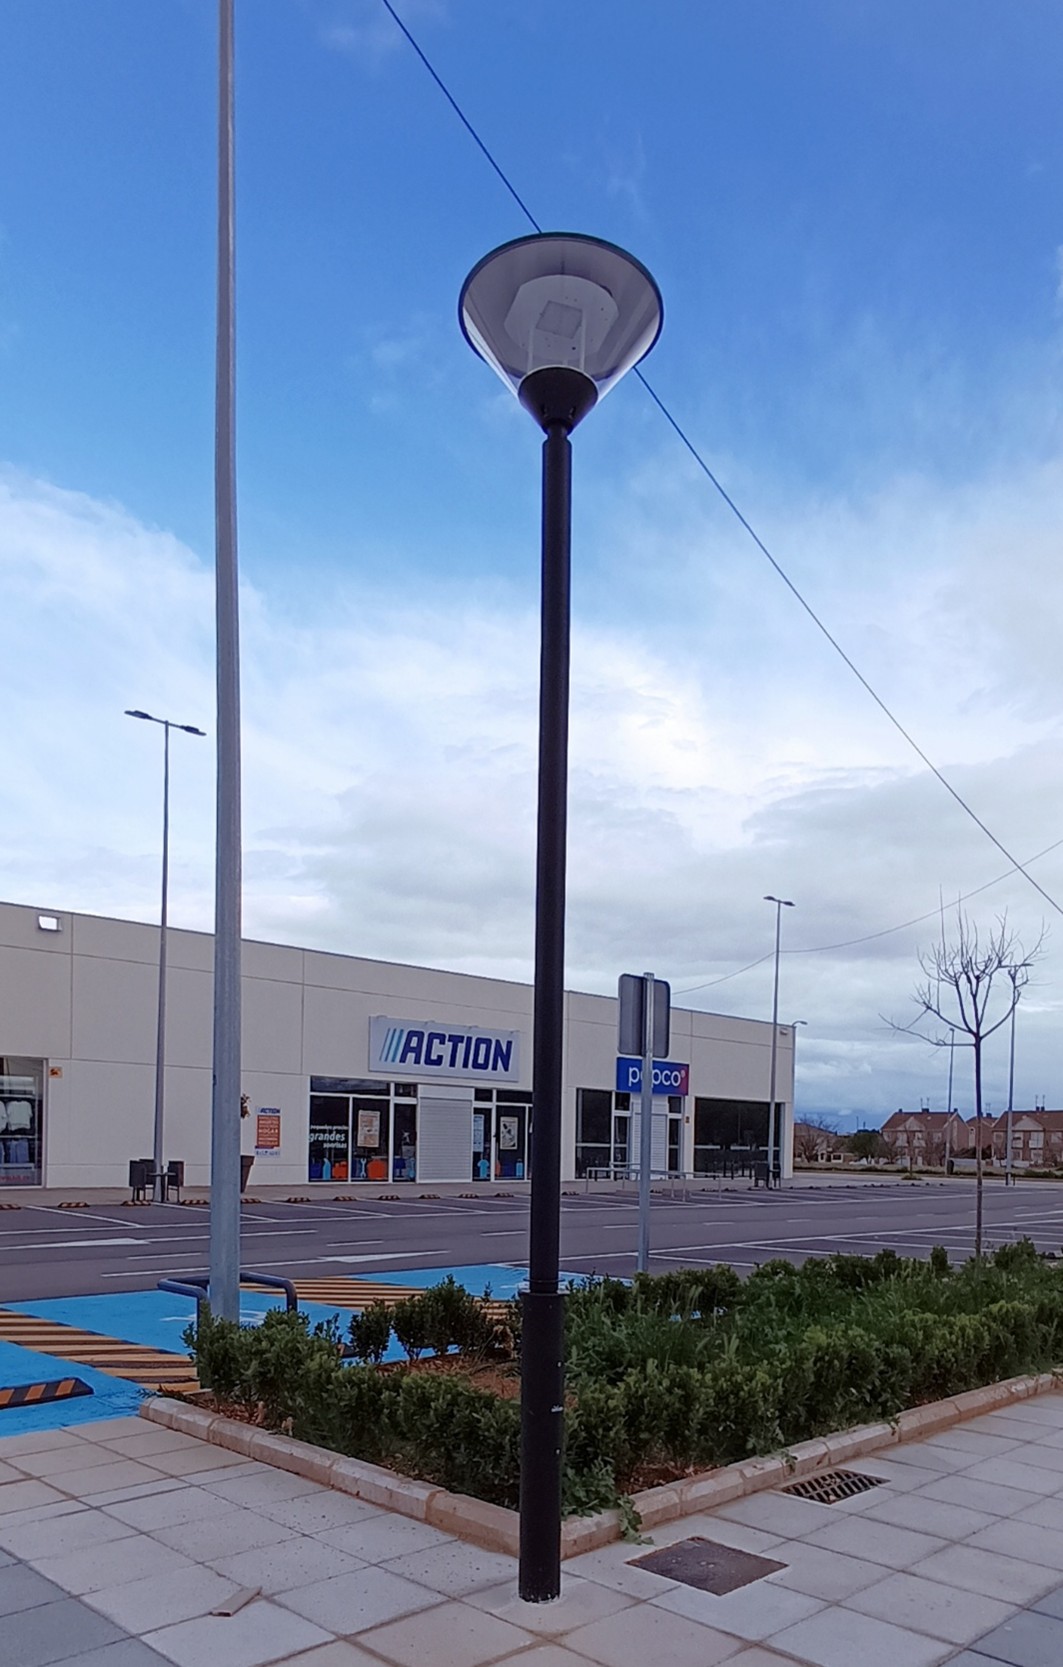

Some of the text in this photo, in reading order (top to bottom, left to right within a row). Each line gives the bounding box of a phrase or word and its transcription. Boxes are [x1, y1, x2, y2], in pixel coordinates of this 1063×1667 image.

[399, 1029, 512, 1072] ACTION
[628, 1066, 681, 1089] ppco
[308, 1130, 345, 1143] grandes
